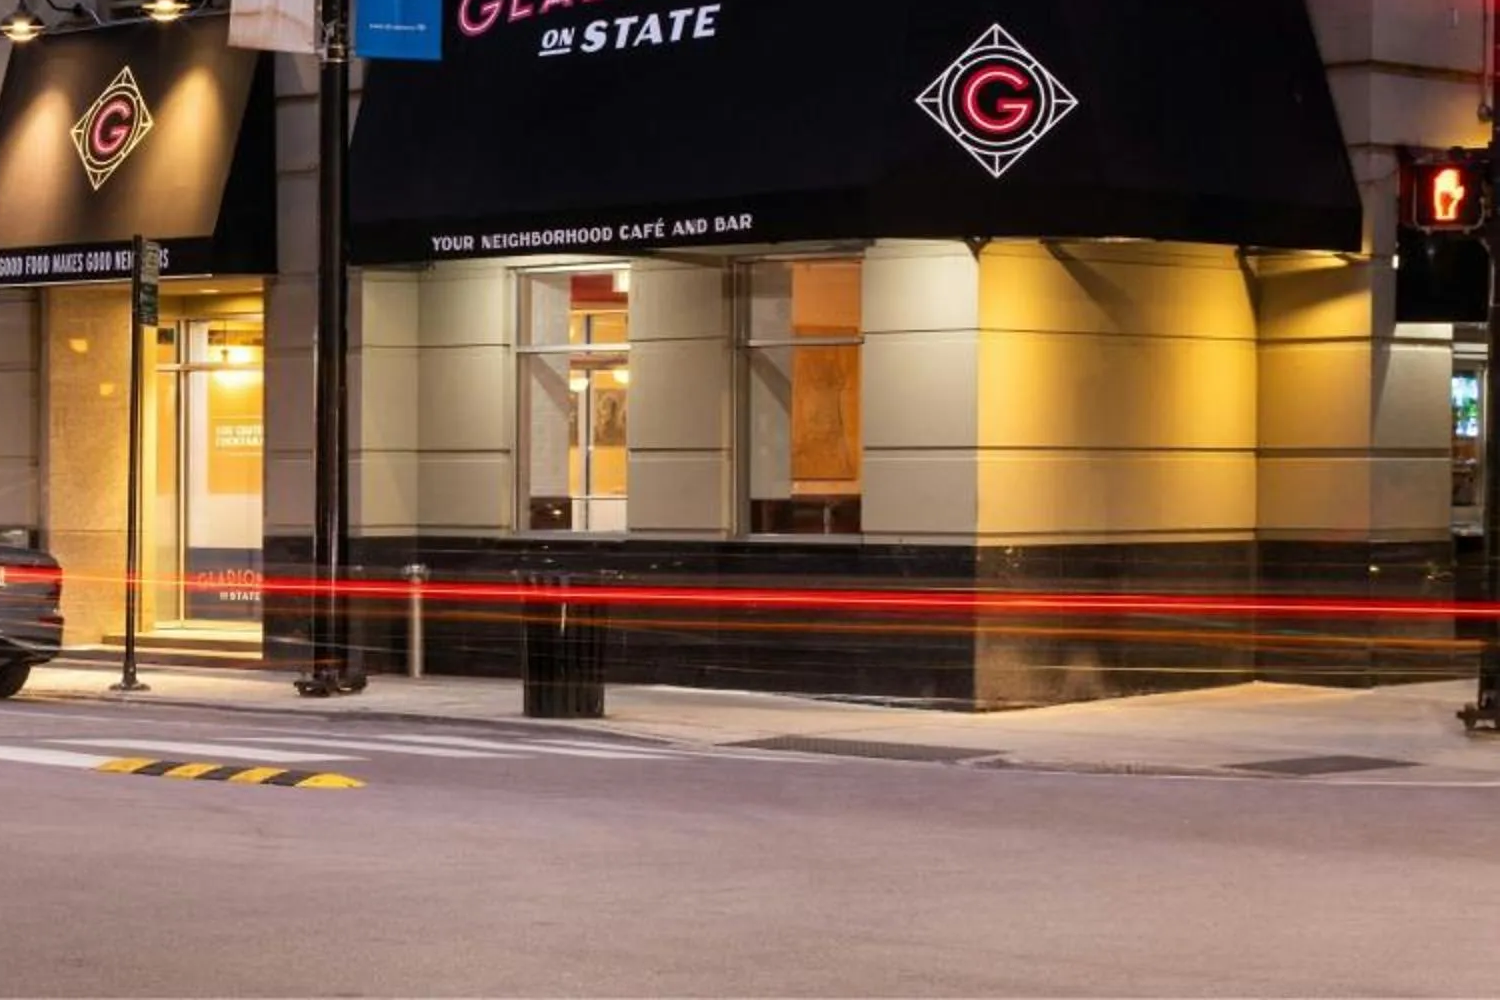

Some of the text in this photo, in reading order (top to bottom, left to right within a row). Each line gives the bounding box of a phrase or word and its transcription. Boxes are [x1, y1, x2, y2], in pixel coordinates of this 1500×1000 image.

[540, 3, 721, 54] ON STATE
[962, 67, 1034, 132] G
[93, 100, 132, 156] G
[432, 213, 753, 252] YOUR NEIGHBORHOOD CAFÉ AND BAR
[25, 254, 50, 276] FOOD
[52, 252, 84, 274] MAKES
[86, 251, 113, 273] GOOD
